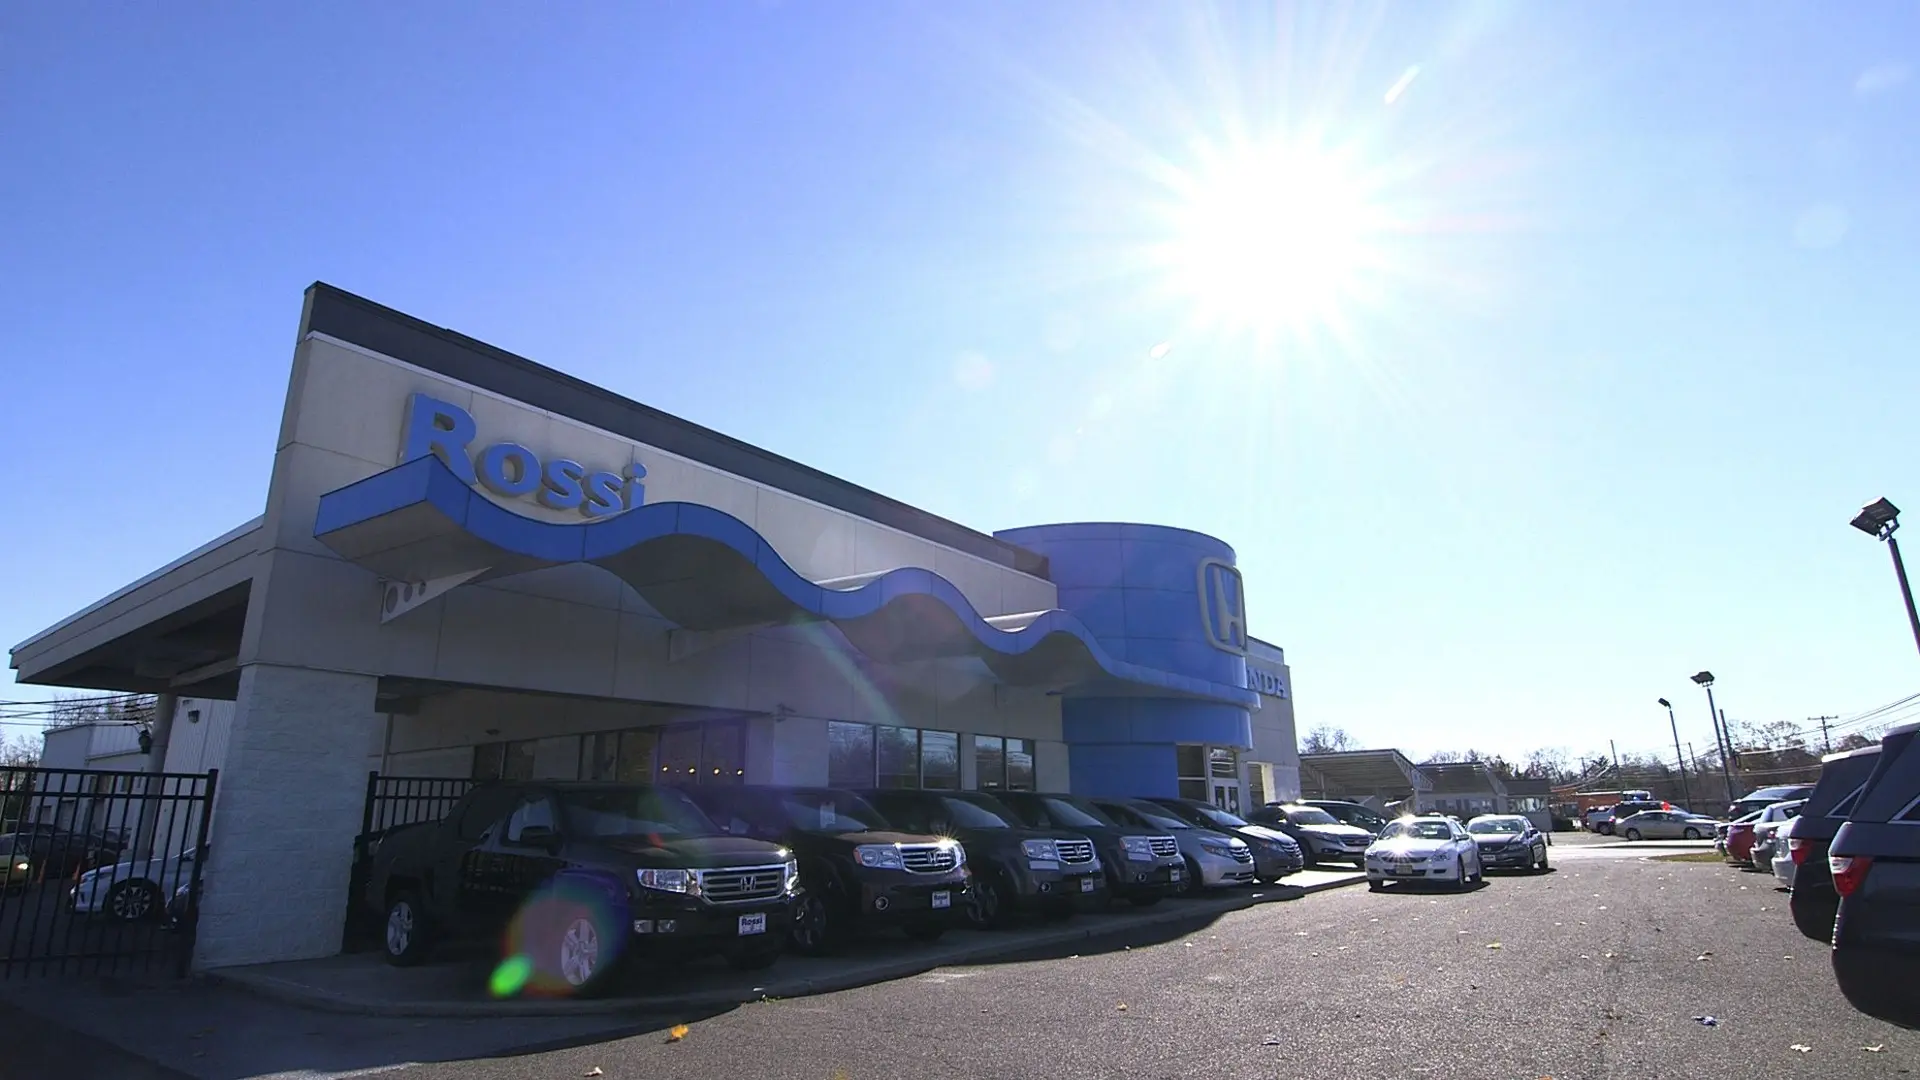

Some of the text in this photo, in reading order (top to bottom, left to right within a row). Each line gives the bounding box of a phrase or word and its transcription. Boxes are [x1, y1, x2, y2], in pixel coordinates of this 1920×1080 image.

[403, 392, 647, 516] Rossi
[1247, 667, 1288, 698] NDA
[741, 916, 763, 925] Rossi
